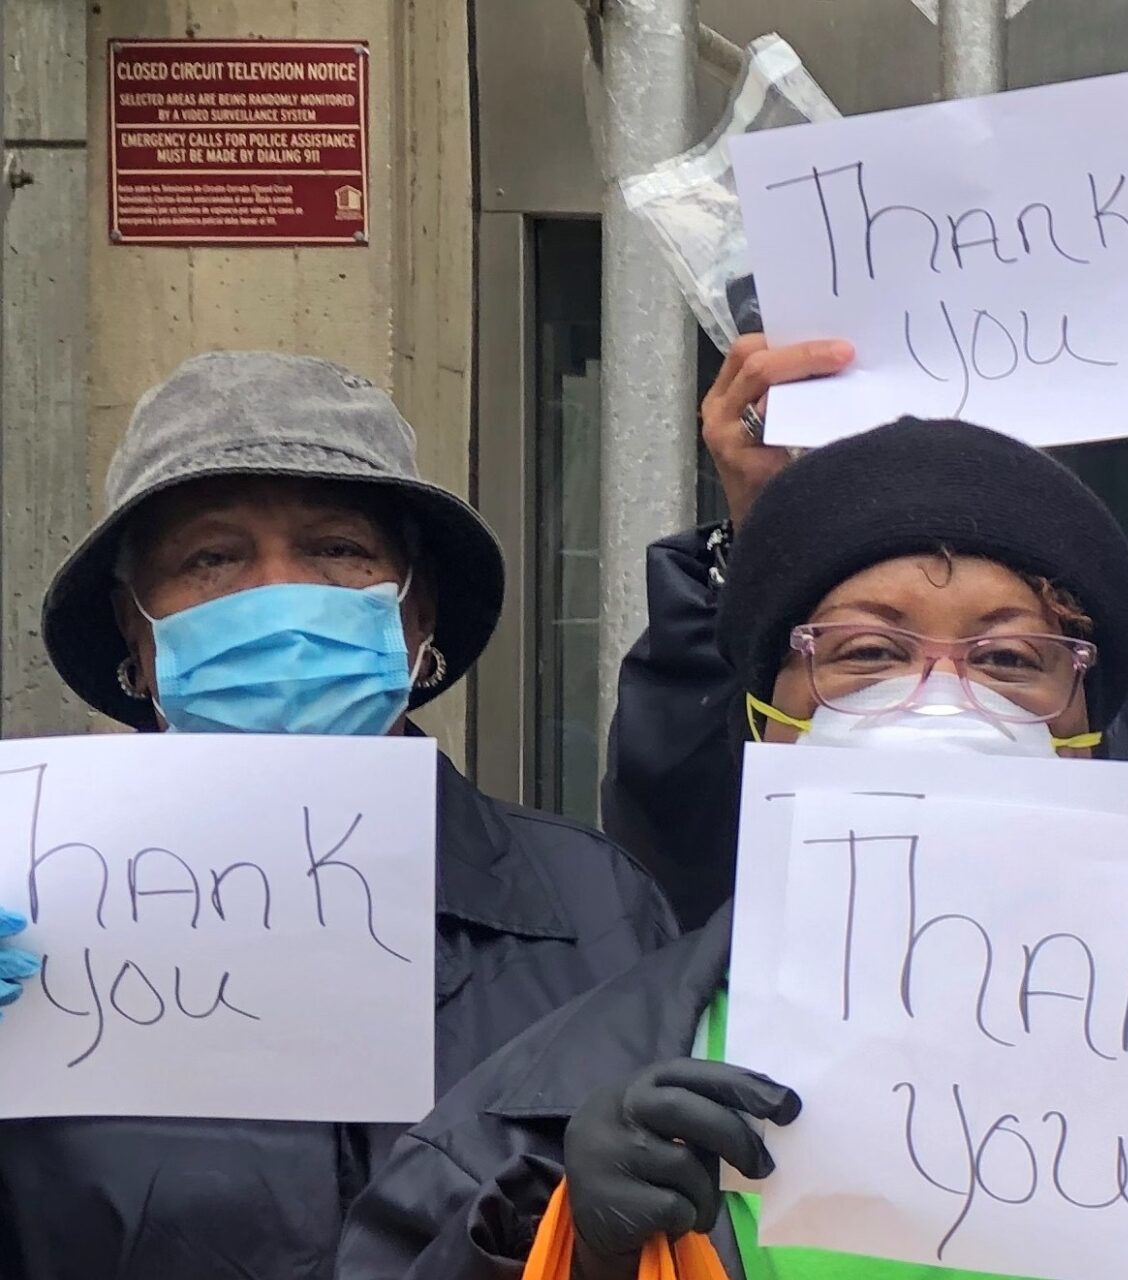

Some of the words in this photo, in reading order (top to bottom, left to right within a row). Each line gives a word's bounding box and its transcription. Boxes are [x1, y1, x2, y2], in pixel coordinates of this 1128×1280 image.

[117, 61, 168, 80] CLOSED
[171, 61, 224, 80] CIRCUIT
[227, 62, 304, 80] TELEVISION
[307, 62, 357, 81] NOTICE
[120, 92, 164, 106] SELECTED
[166, 92, 196, 106] AREAS
[198, 92, 216, 106] ARE
[218, 92, 247, 106] BEING
[248, 92, 299, 106] RANDOMLY
[300, 92, 355, 106] MONITORED
[157, 108, 171, 121] BY
[172, 108, 180, 120] A
[181, 108, 209, 121] VIDEO
[210, 108, 279, 121] SURVEILLANCE
[280, 108, 316, 121] SYSTEM
[121, 132, 187, 147] EMERGENCY
[188, 132, 223, 148] CALLS
[224, 132, 247, 148] FOR
[249, 132, 288, 148] POLICE
[290, 132, 356, 148] ASSISTANCE
[156, 148, 187, 162] MUST
[188, 148, 204, 163] BE
[205, 148, 238, 163] MADE
[239, 148, 255, 163] BY
[256, 148, 302, 163] DIALING
[303, 149, 321, 163] 911
